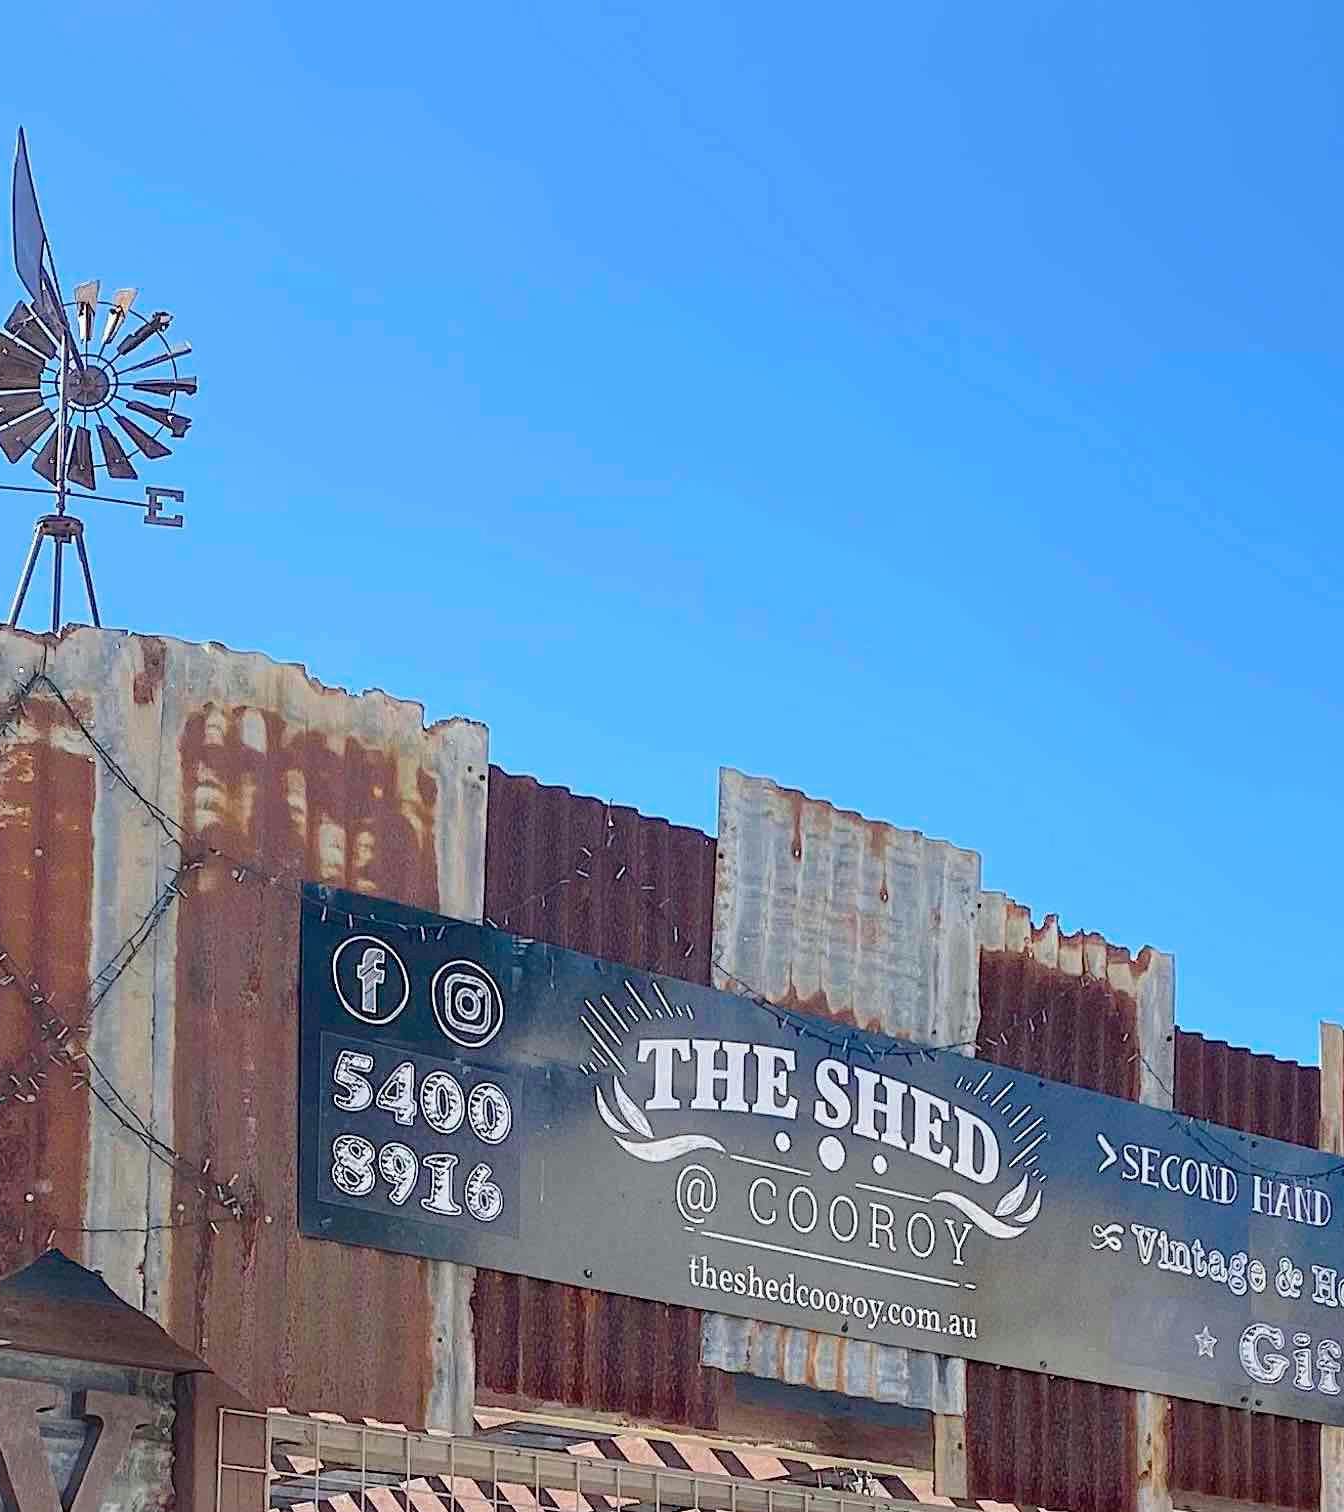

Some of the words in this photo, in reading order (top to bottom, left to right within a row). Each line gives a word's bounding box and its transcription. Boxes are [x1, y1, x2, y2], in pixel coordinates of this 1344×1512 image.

[144, 487, 184, 528] E
[332, 1051, 513, 1145] 5400
[637, 1039, 798, 1119] THE
[813, 1058, 1000, 1185] SHED
[331, 1134, 505, 1222] 8916
[675, 1165, 718, 1225] @
[748, 1178, 975, 1266] COOROY
[1121, 1143, 1238, 1205] SECOND
[1252, 1176, 1333, 1228] HAND
[688, 1254, 978, 1340] theshedcooroy.com.au
[1131, 1222, 1267, 1296] Vintage
[1275, 1256, 1304, 1299] &
